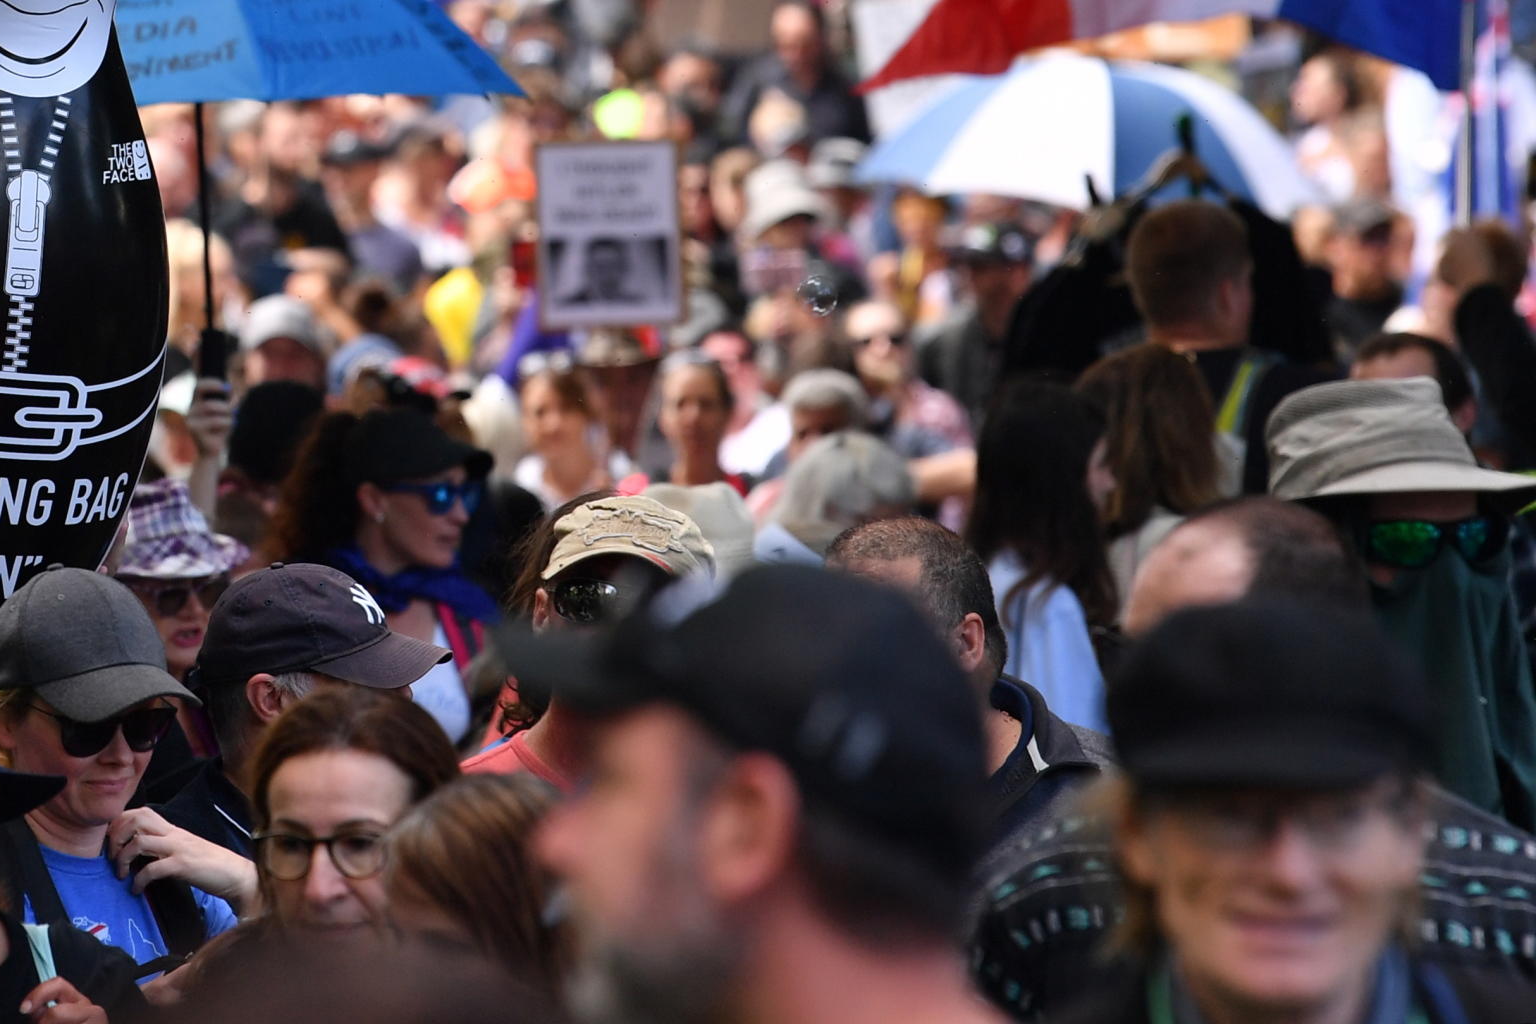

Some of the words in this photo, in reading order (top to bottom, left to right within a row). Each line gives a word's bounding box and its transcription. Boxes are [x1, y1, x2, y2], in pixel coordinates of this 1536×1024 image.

[111, 142, 134, 158] THE
[107, 155, 134, 172] TWO
[102, 168, 135, 185] FACE
[65, 472, 129, 526] BAG
